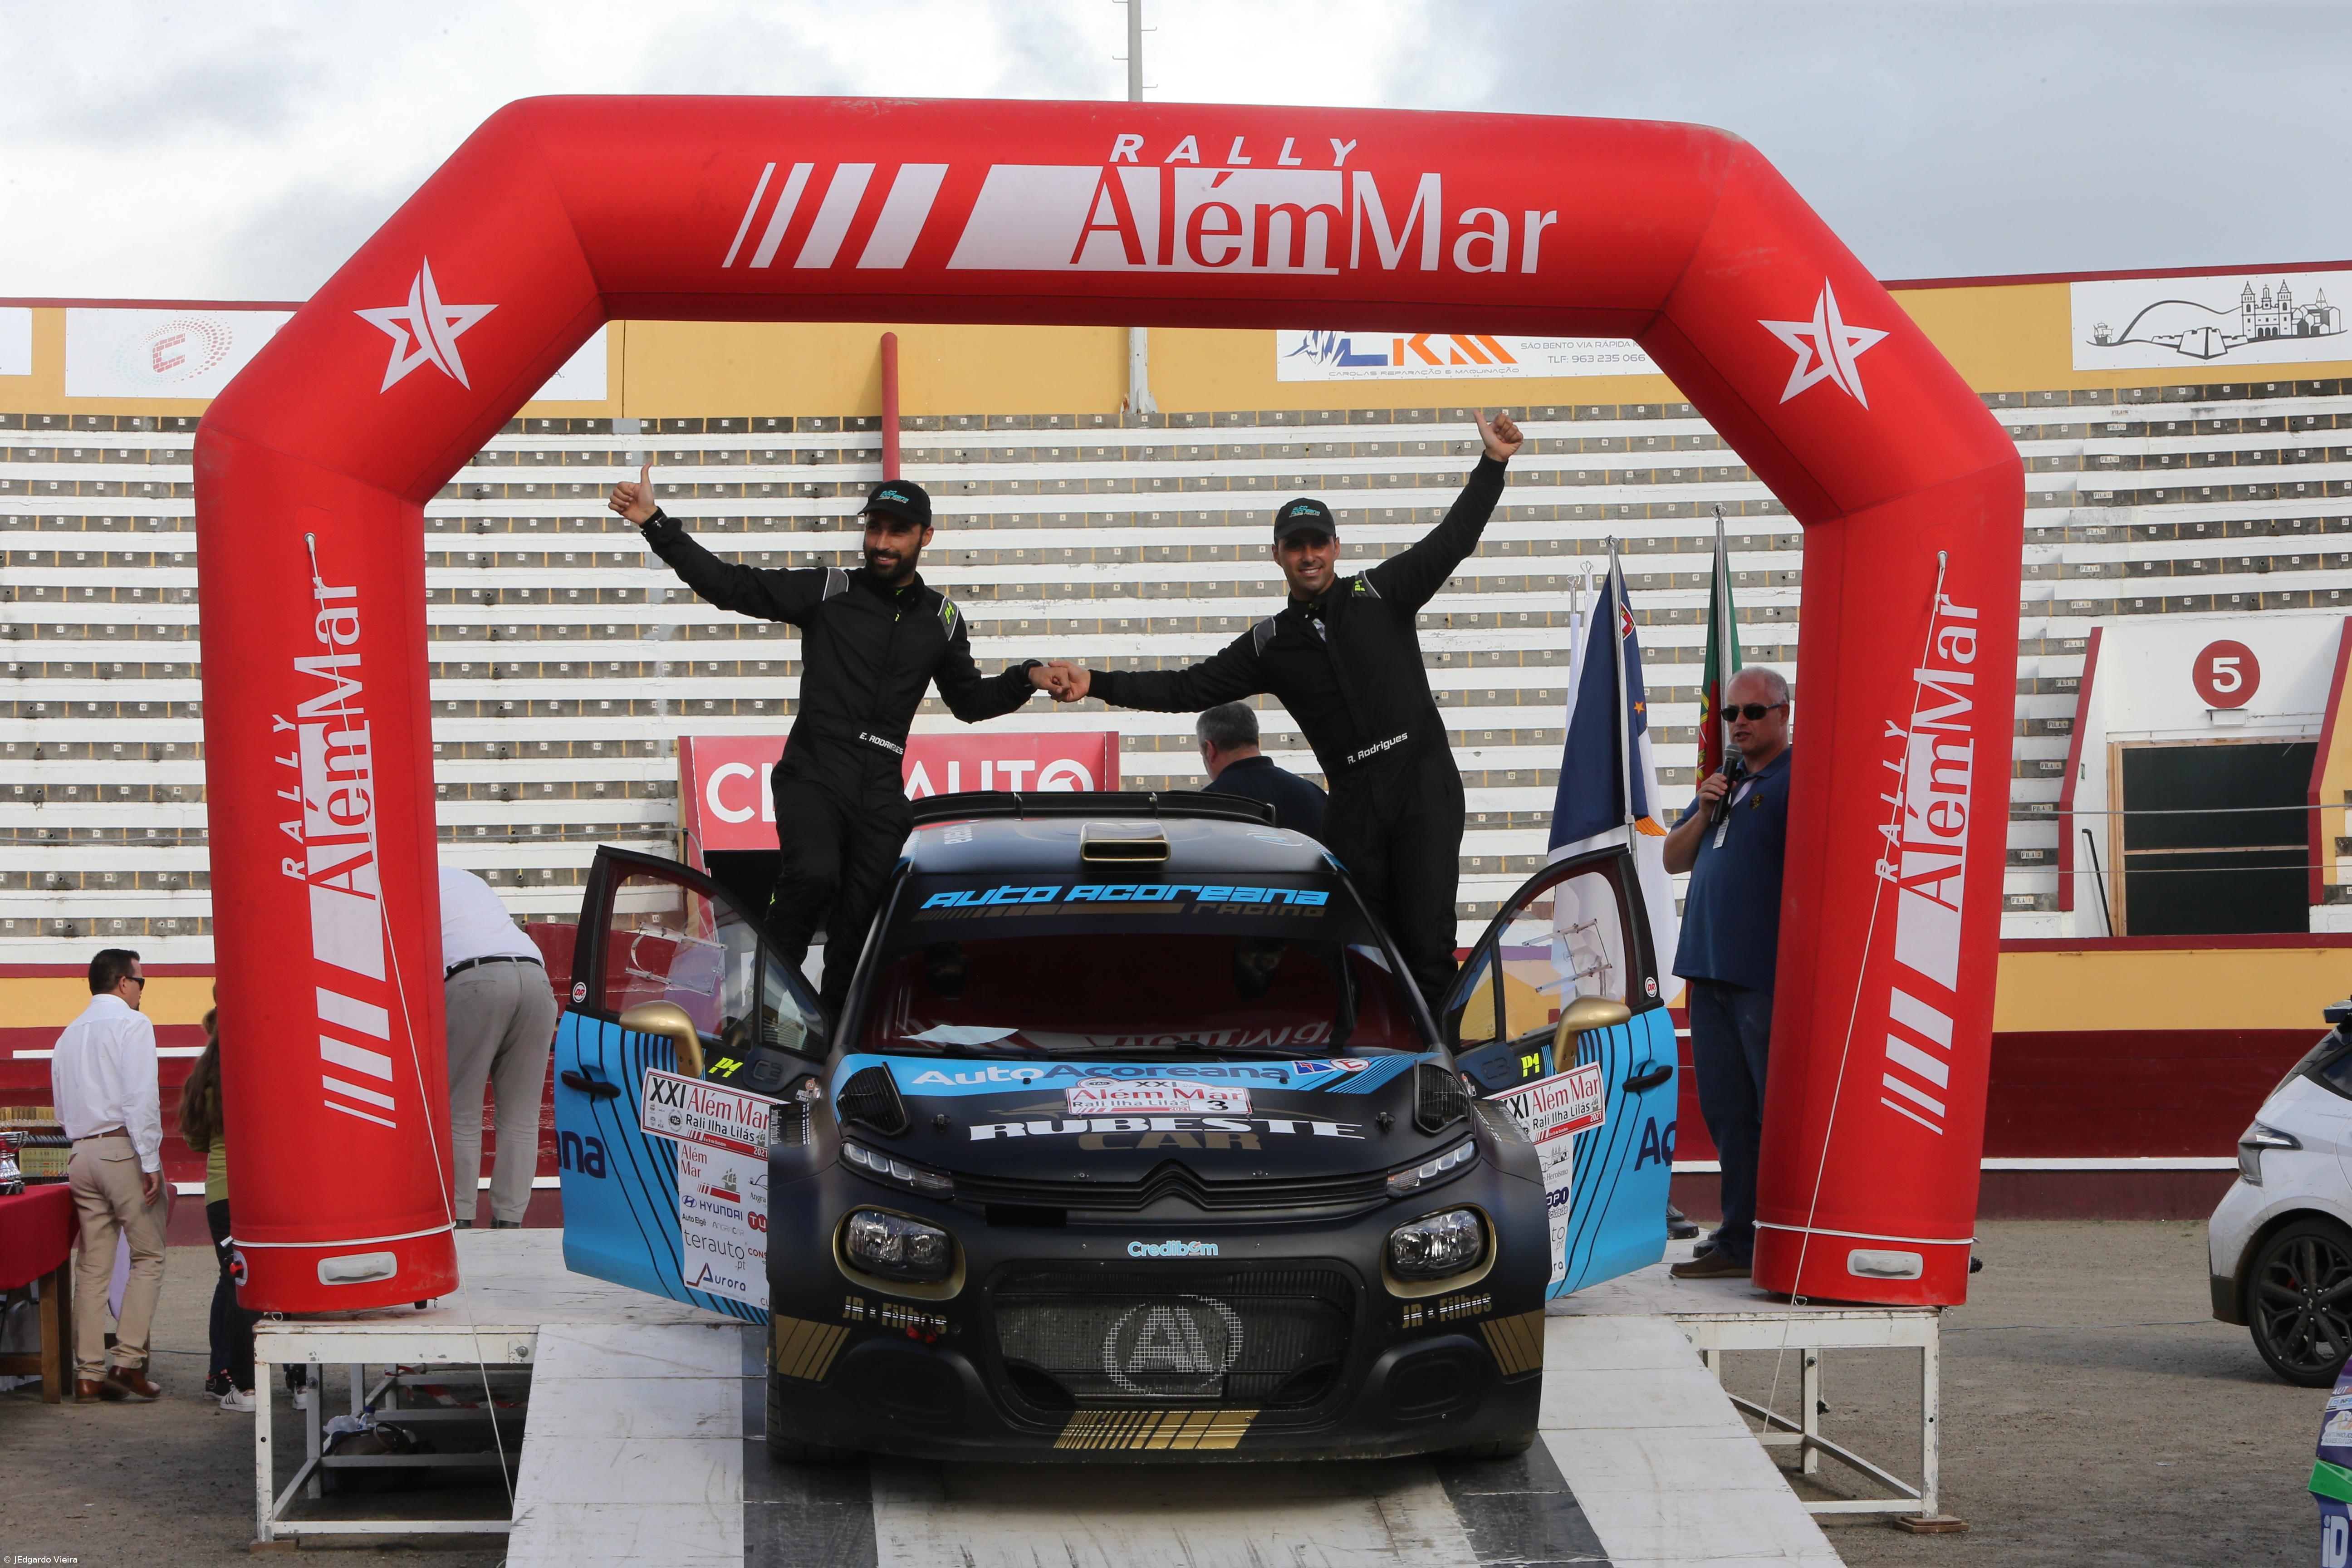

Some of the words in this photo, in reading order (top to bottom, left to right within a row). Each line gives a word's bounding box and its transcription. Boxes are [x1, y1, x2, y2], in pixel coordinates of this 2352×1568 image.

[1110, 134, 1357, 166] RALLY
[1521, 341, 1541, 350] SÃO
[1595, 340, 1631, 348] RÁPIDA
[1548, 355, 1569, 363] TLF:
[1597, 354, 1620, 363] 235
[1622, 354, 1646, 362] 066
[1455, 367, 1519, 375] MAQUINAÇÃO
[2212, 657, 2243, 693] 5
[859, 732, 867, 740] E.
[1347, 755, 1356, 764] R.
[1357, 732, 1408, 760] Rodrigues
[273, 714, 305, 881] RALLY
[1875, 720, 1907, 883] RALLY
[650, 1077, 686, 1108] XXI
[687, 1087, 732, 1121] Além
[735, 1098, 769, 1130] Mar
[1073, 1088, 1163, 1100] Além
[1173, 1088, 1243, 1100] Mar
[1532, 1086, 1569, 1116] Além
[1569, 1075, 1598, 1102] Mar
[1207, 1100, 1229, 1111] 3
[1533, 1116, 1550, 1130] Rali
[1552, 1111, 1568, 1124] Ilha
[1571, 1101, 1590, 1117] Lilás
[1590, 1111, 1602, 1122] 2021
[686, 1114, 706, 1130] Rali
[708, 1119, 727, 1135] Ilha
[730, 1125, 755, 1142] Lilás
[969, 1117, 1365, 1141] RUBESTE
[1078, 1132, 1262, 1150] CAR
[681, 1144, 707, 1165] Além
[754, 1147, 768, 1158] 2021
[681, 1159, 701, 1178] Mar
[1546, 1168, 1568, 1181] Heroísmo
[750, 1192, 766, 1204] Angra
[682, 1213, 695, 1223] Auto
[695, 1216, 706, 1226] Elgê
[699, 1200, 743, 1220] HYUNDAI
[684, 1230, 745, 1259] terauto
[1127, 1240, 1219, 1257] Credibom
[686, 1262, 746, 1291] Aurora
[882, 1303, 947, 1334] Filhos
[1402, 1303, 1423, 1329] JR
[1439, 1293, 1492, 1322] Filhos
